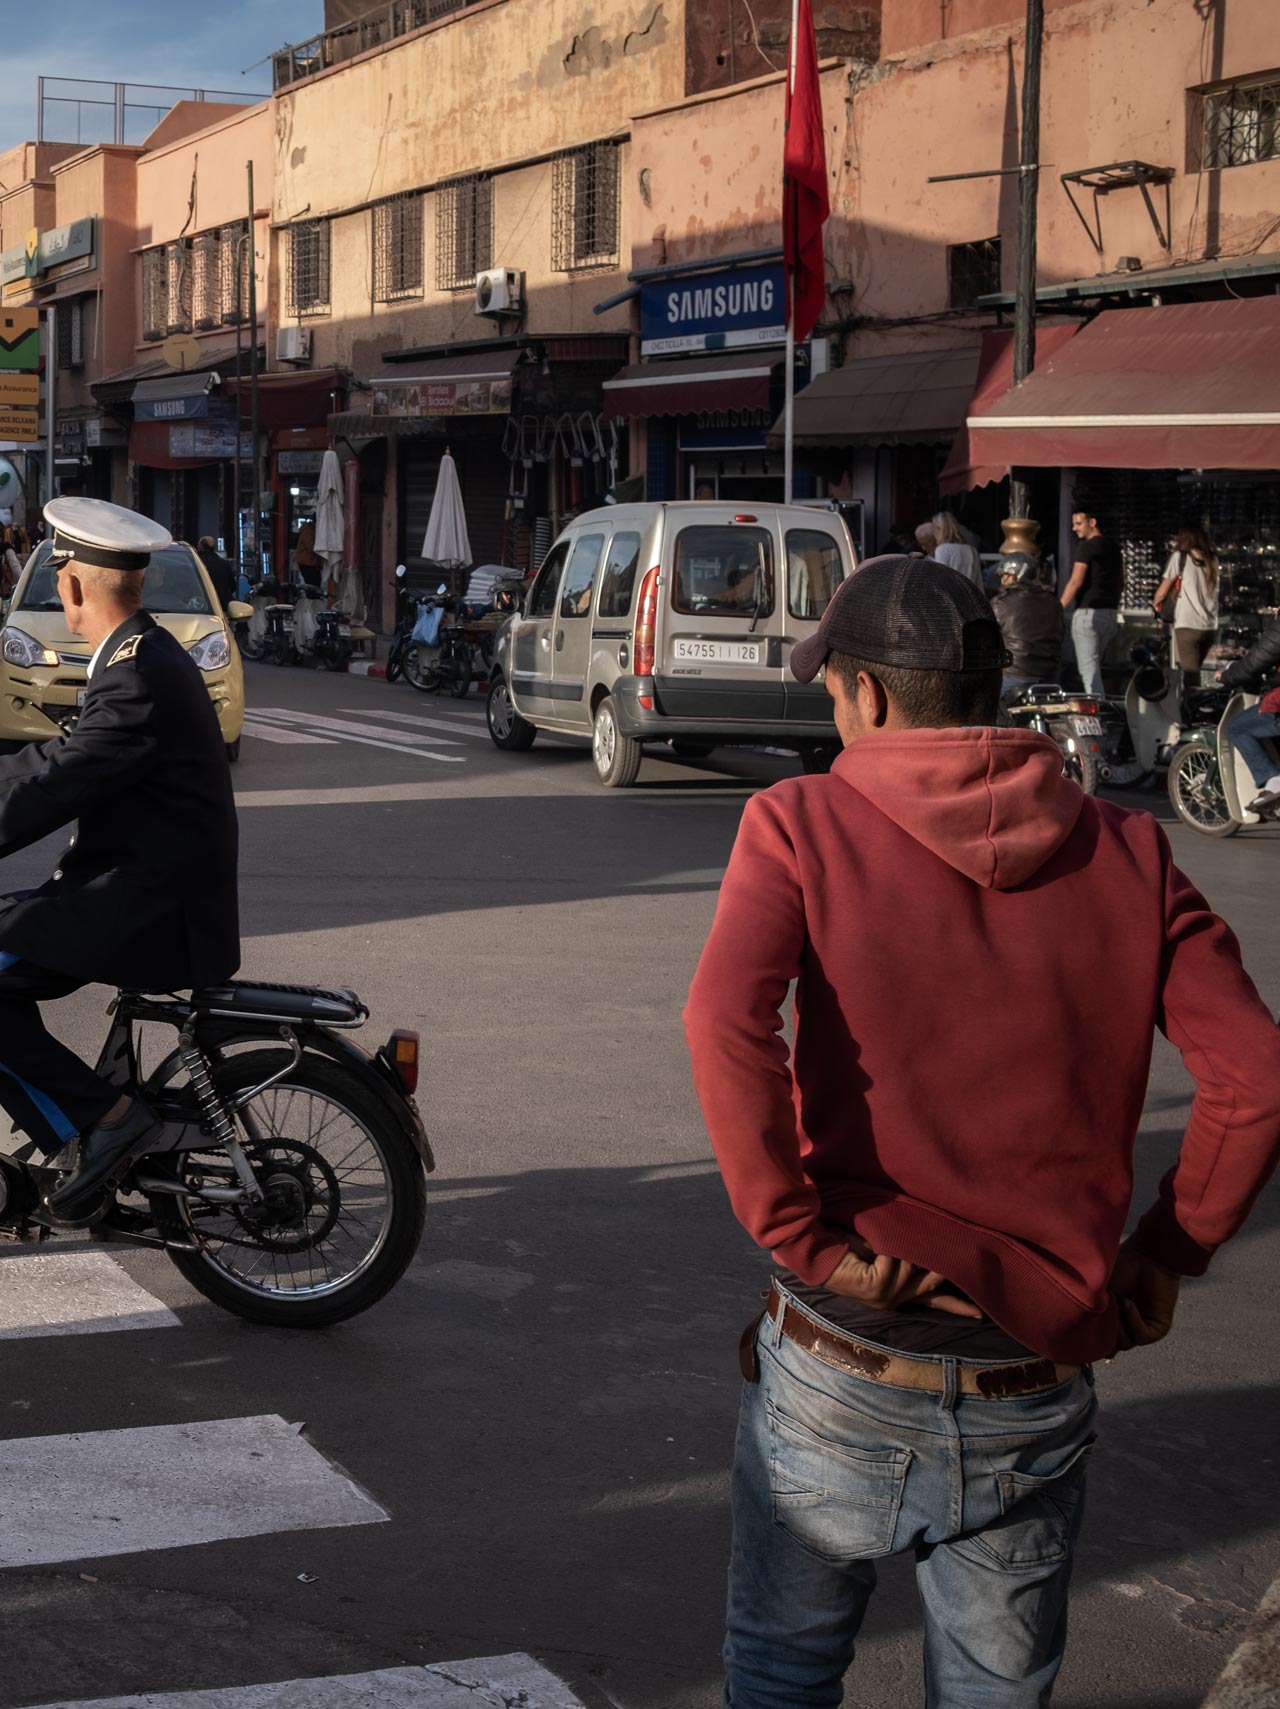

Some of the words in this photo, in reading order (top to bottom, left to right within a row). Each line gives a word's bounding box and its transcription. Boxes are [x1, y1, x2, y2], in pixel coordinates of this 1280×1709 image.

[667, 279, 774, 323] SAMSUNG
[3, 384, 38, 393] Assurance
[153, 400, 185, 417] SAMSUNG
[679, 643, 716, 658] 54755
